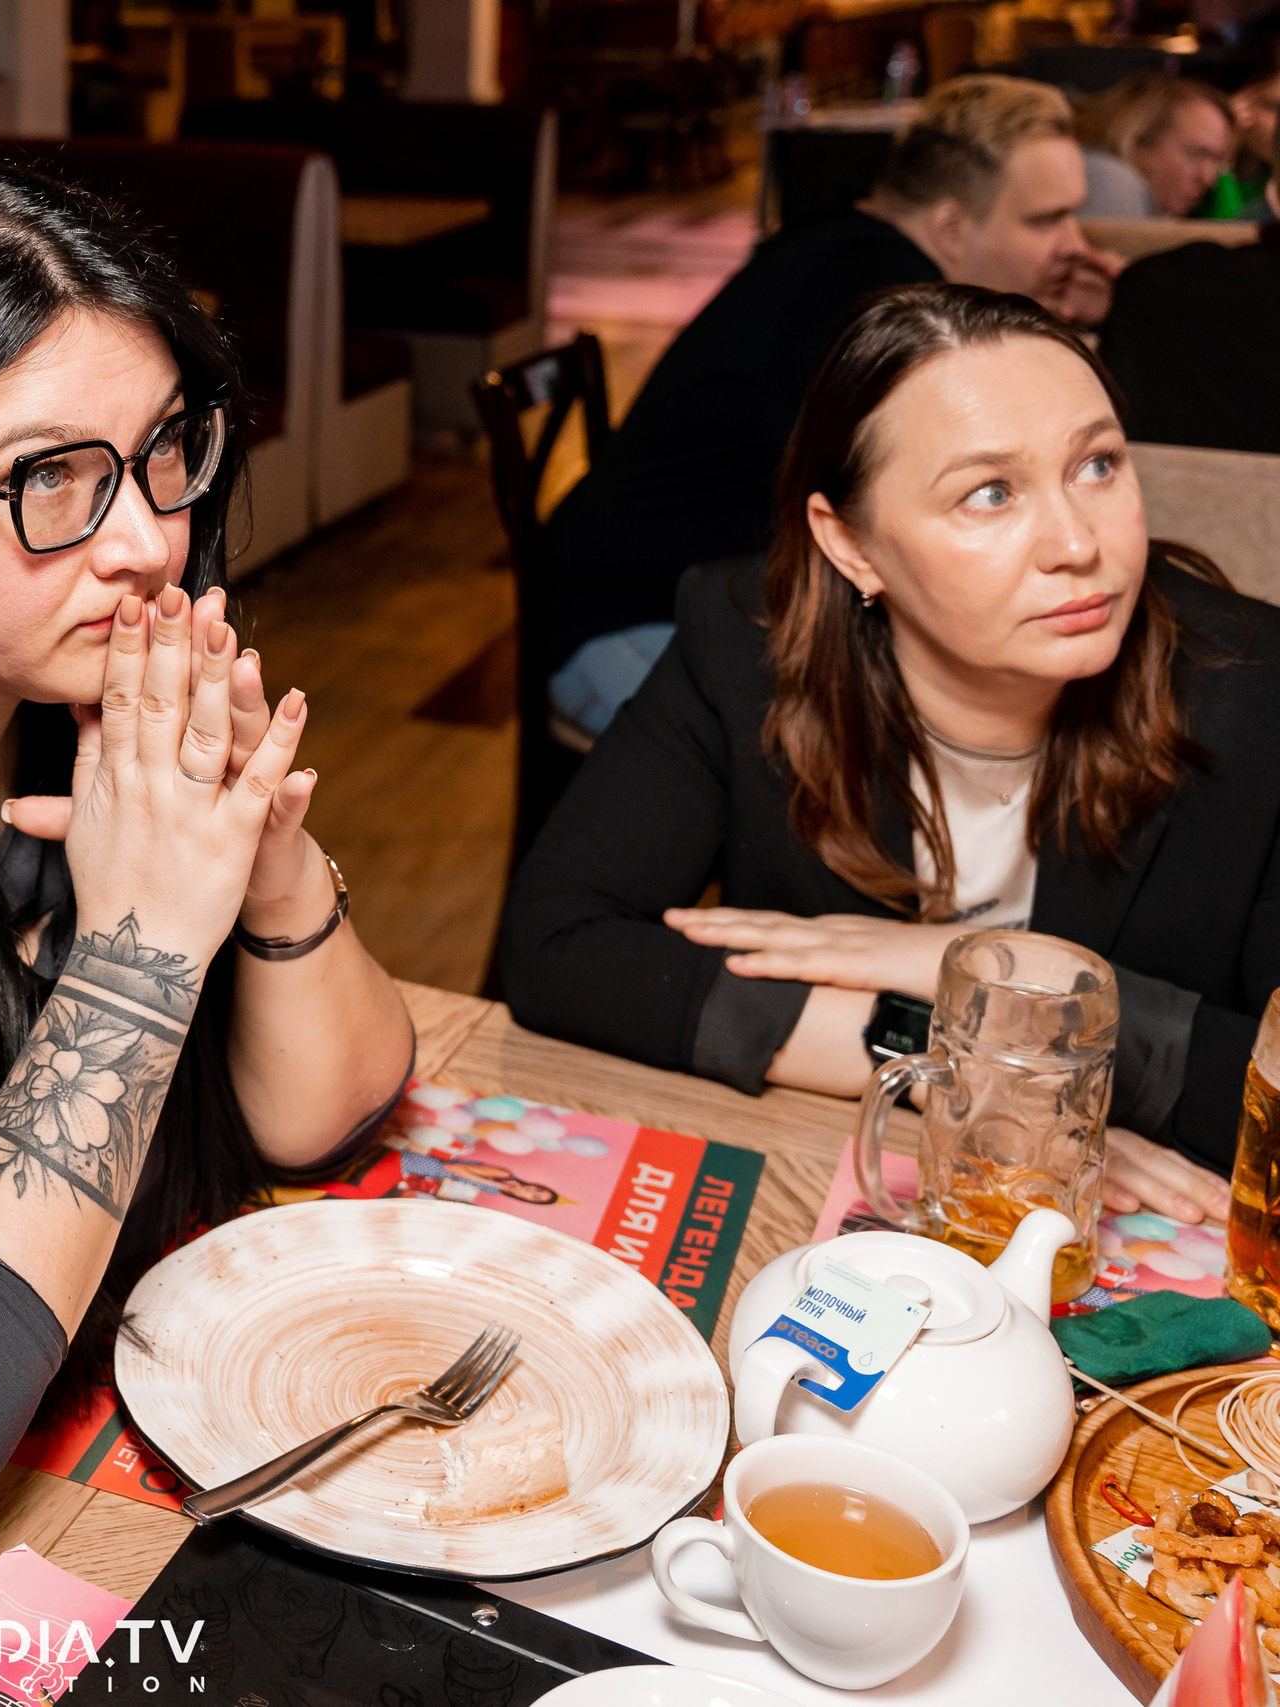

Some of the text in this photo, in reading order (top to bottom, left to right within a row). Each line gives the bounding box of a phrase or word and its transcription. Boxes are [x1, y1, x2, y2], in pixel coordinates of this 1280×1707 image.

[608, 1162, 676, 1272] ДЛЯ И
[663, 1174, 735, 1320] ЛЕГЕНДА
[795, 1297, 826, 1319] УЛУН
[804, 1285, 868, 1324] МОЛОЧНЫЙ
